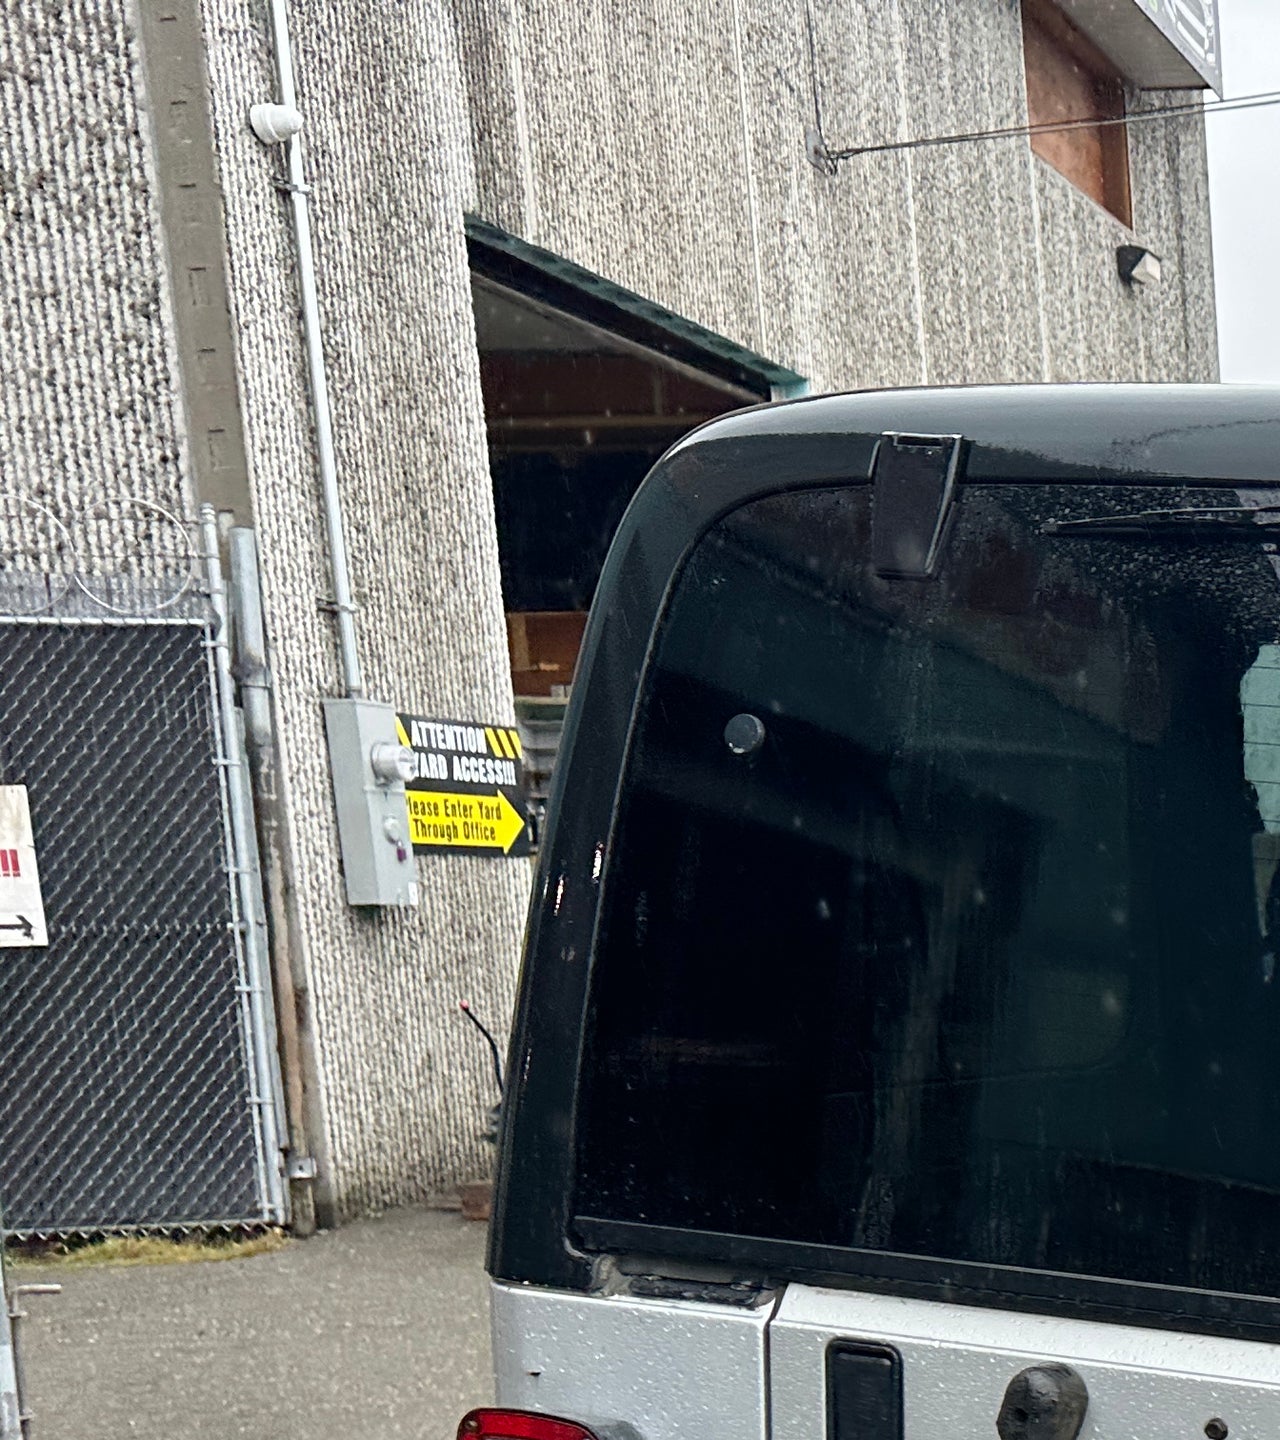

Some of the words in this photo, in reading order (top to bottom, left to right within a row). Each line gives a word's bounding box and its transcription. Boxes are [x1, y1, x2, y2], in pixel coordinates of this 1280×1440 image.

[411, 720, 487, 754] ATTENTION
[406, 795, 439, 817] lease
[444, 798, 473, 819] Enter
[477, 801, 502, 821] Yard
[413, 818, 459, 842] Through
[463, 821, 496, 841] Office
